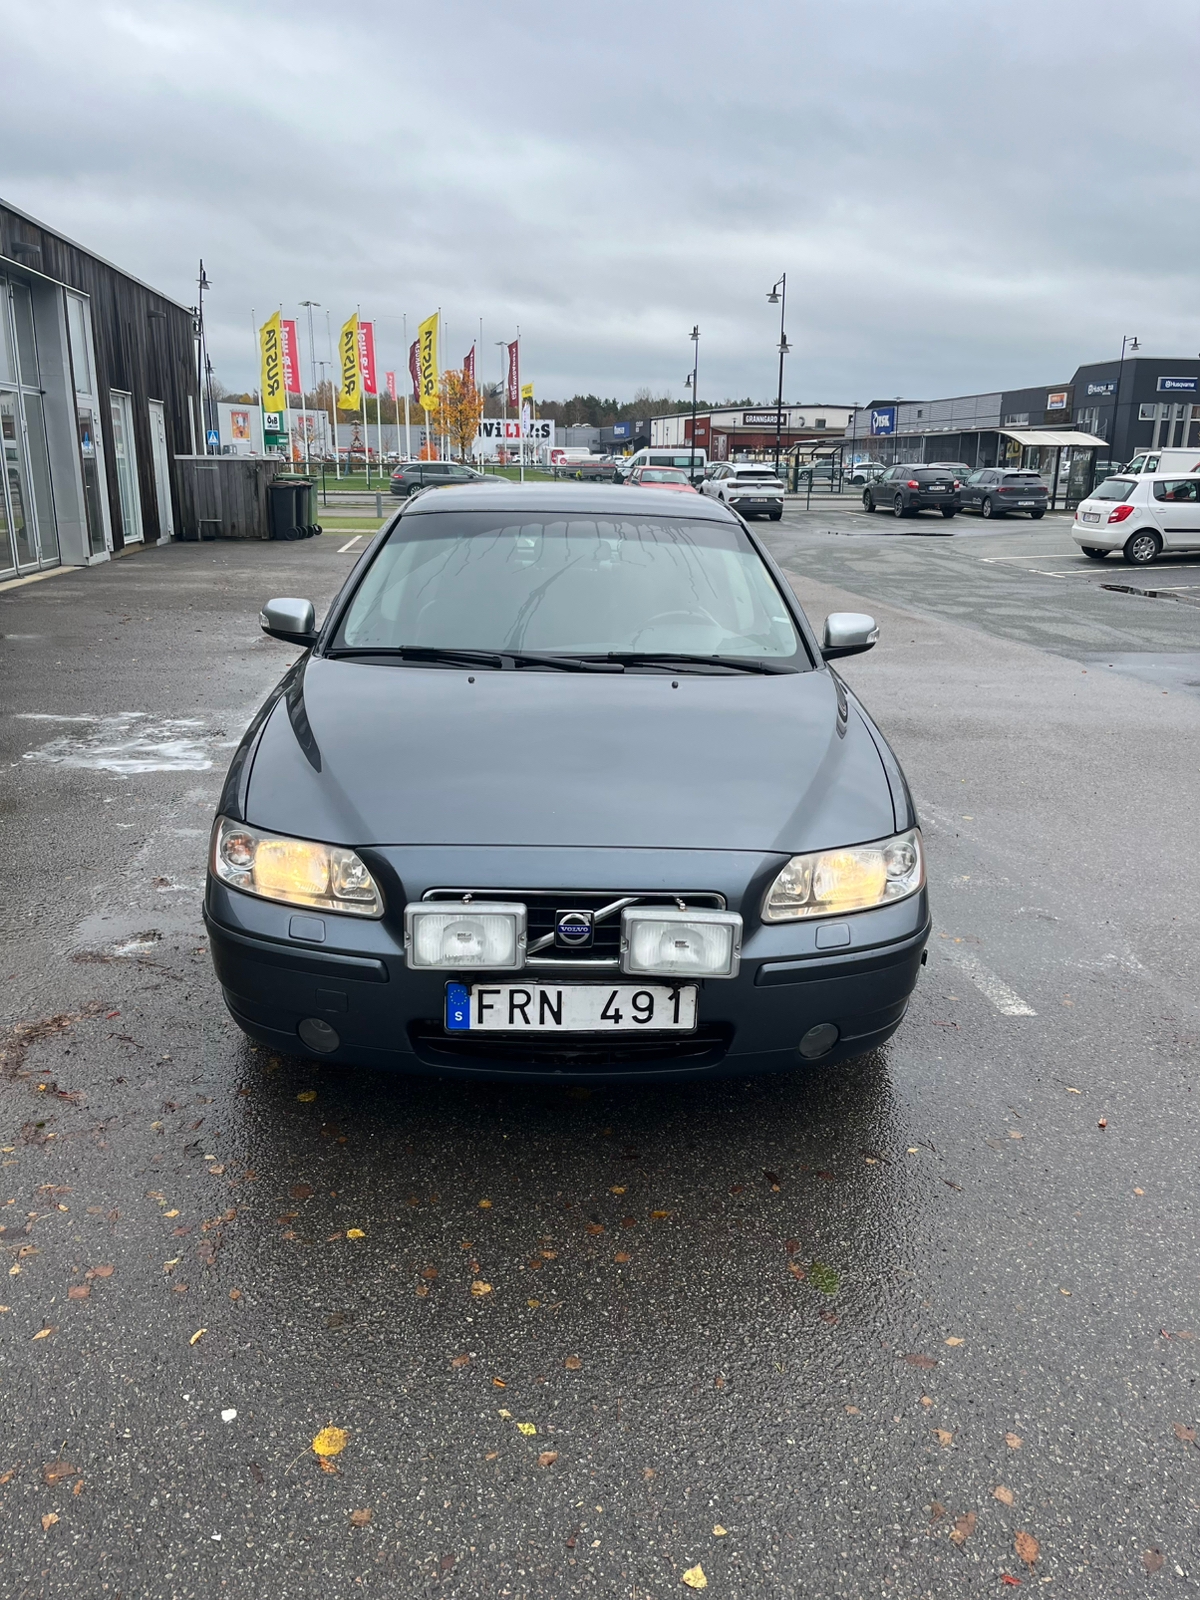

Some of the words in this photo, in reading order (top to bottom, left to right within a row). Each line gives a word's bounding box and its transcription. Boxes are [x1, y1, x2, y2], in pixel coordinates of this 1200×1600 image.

[454, 1011, 463, 1021] S
[477, 989, 562, 1025] FRN
[600, 989, 681, 1024] 491
